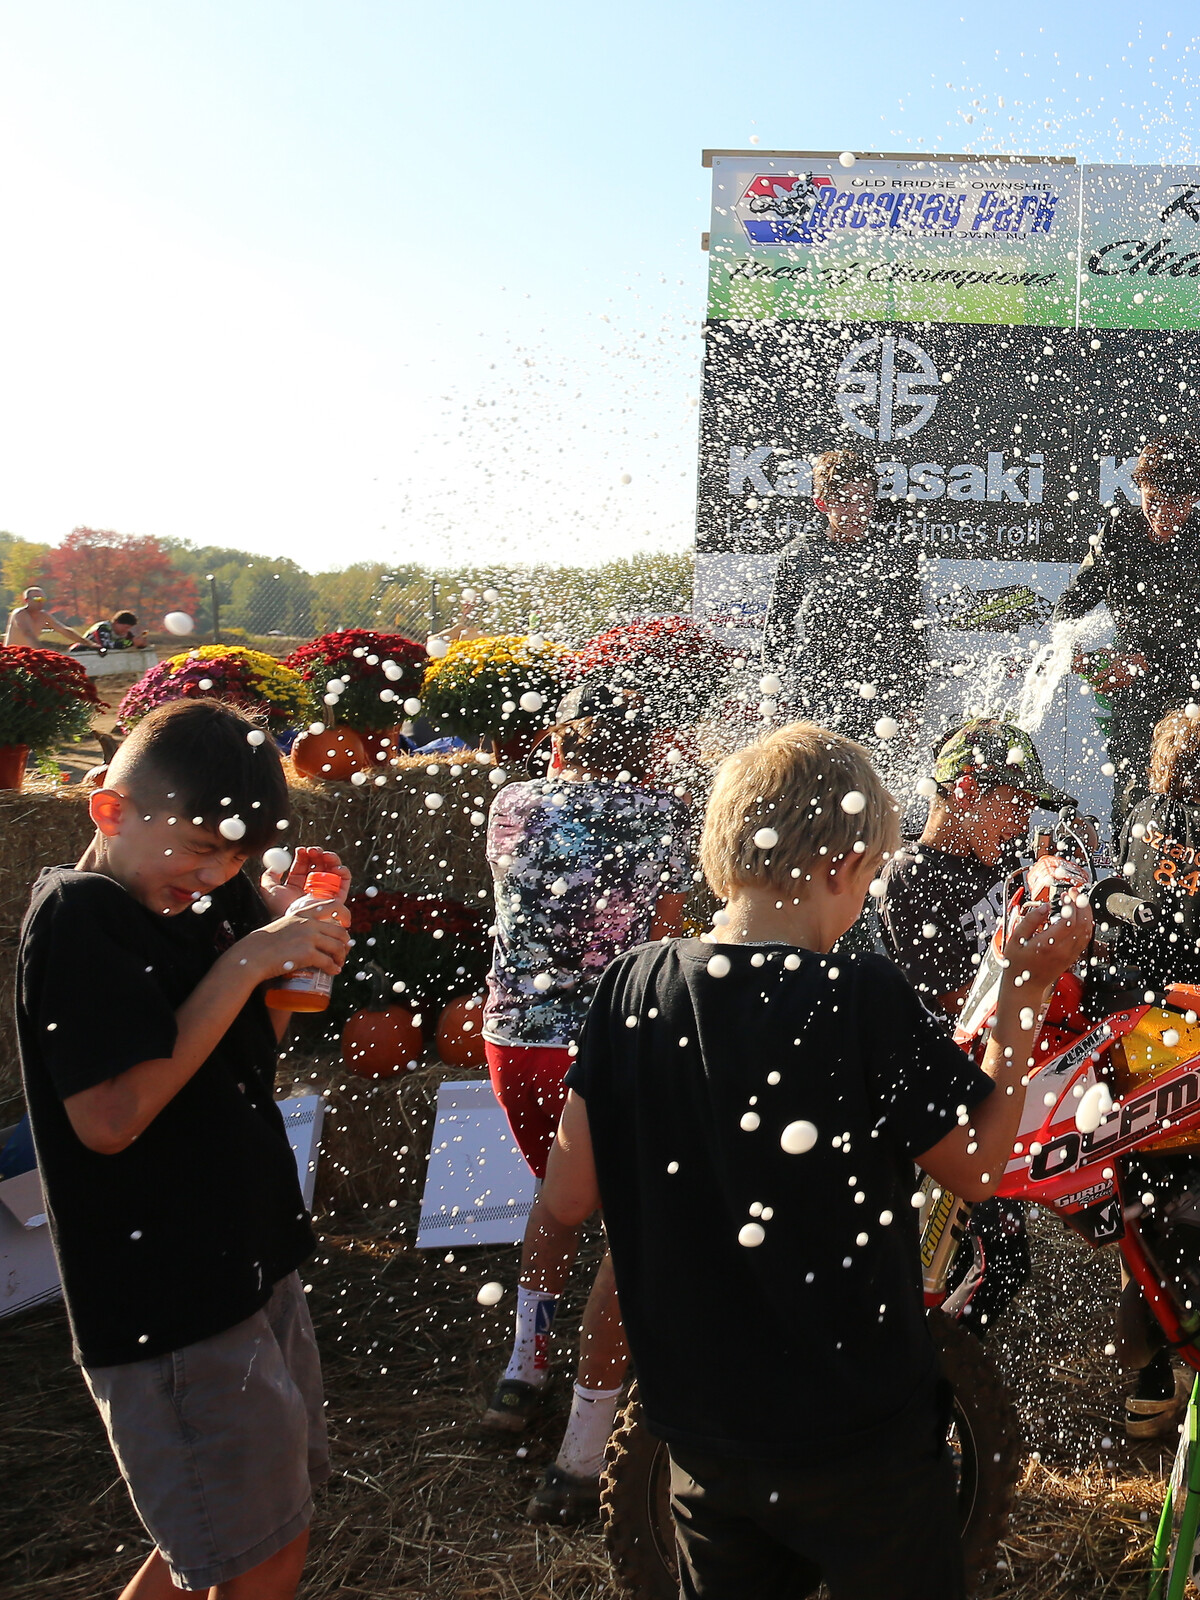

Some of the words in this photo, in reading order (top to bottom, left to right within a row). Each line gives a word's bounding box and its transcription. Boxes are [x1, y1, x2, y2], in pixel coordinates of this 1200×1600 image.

[962, 181, 1052, 191] OWNSHIP
[809, 186, 967, 229] Raceway
[971, 190, 1060, 234] Park
[728, 258, 807, 282] Race
[866, 260, 1057, 289] Champions
[728, 446, 1044, 503] Kaasaki
[1153, 860, 1200, 896] 84
